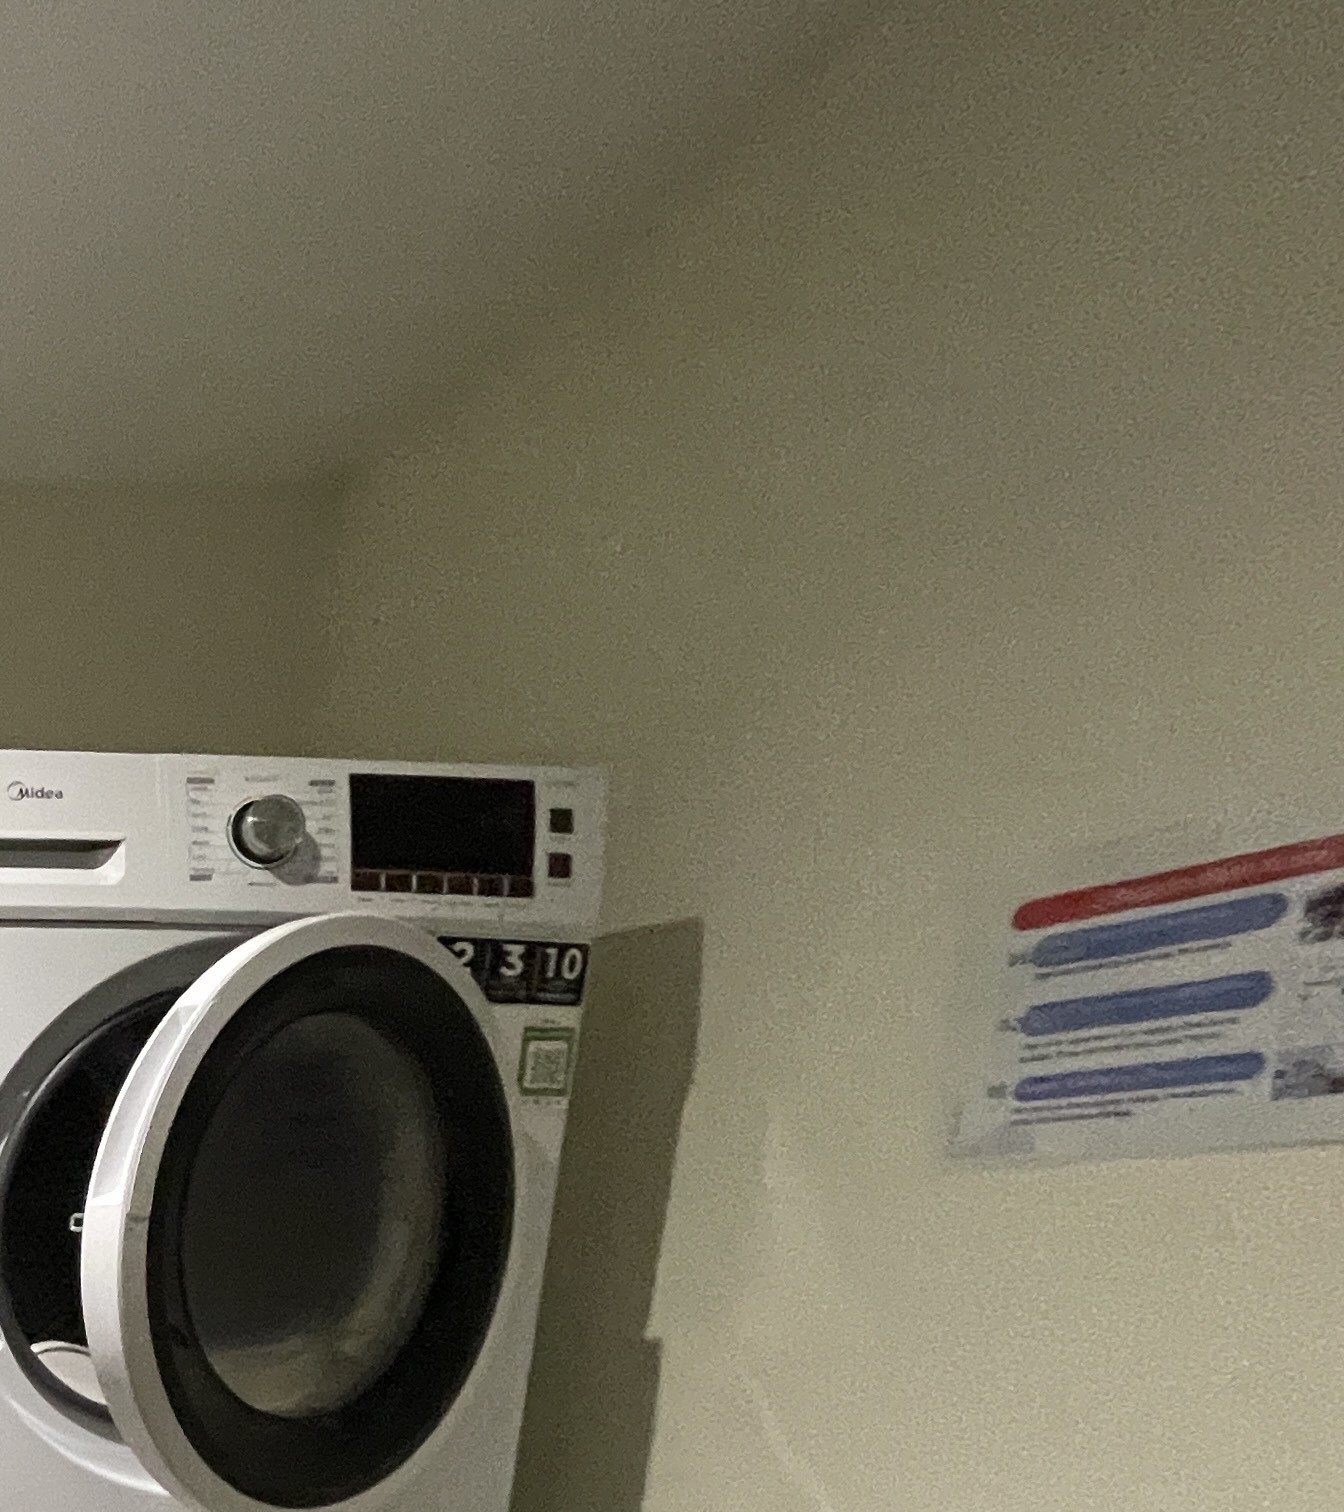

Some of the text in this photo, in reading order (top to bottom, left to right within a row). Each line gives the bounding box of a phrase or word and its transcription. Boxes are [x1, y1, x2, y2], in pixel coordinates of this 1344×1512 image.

[8, 781, 64, 801] Midea
[500, 944, 526, 977] 3
[544, 948, 583, 980] 10
